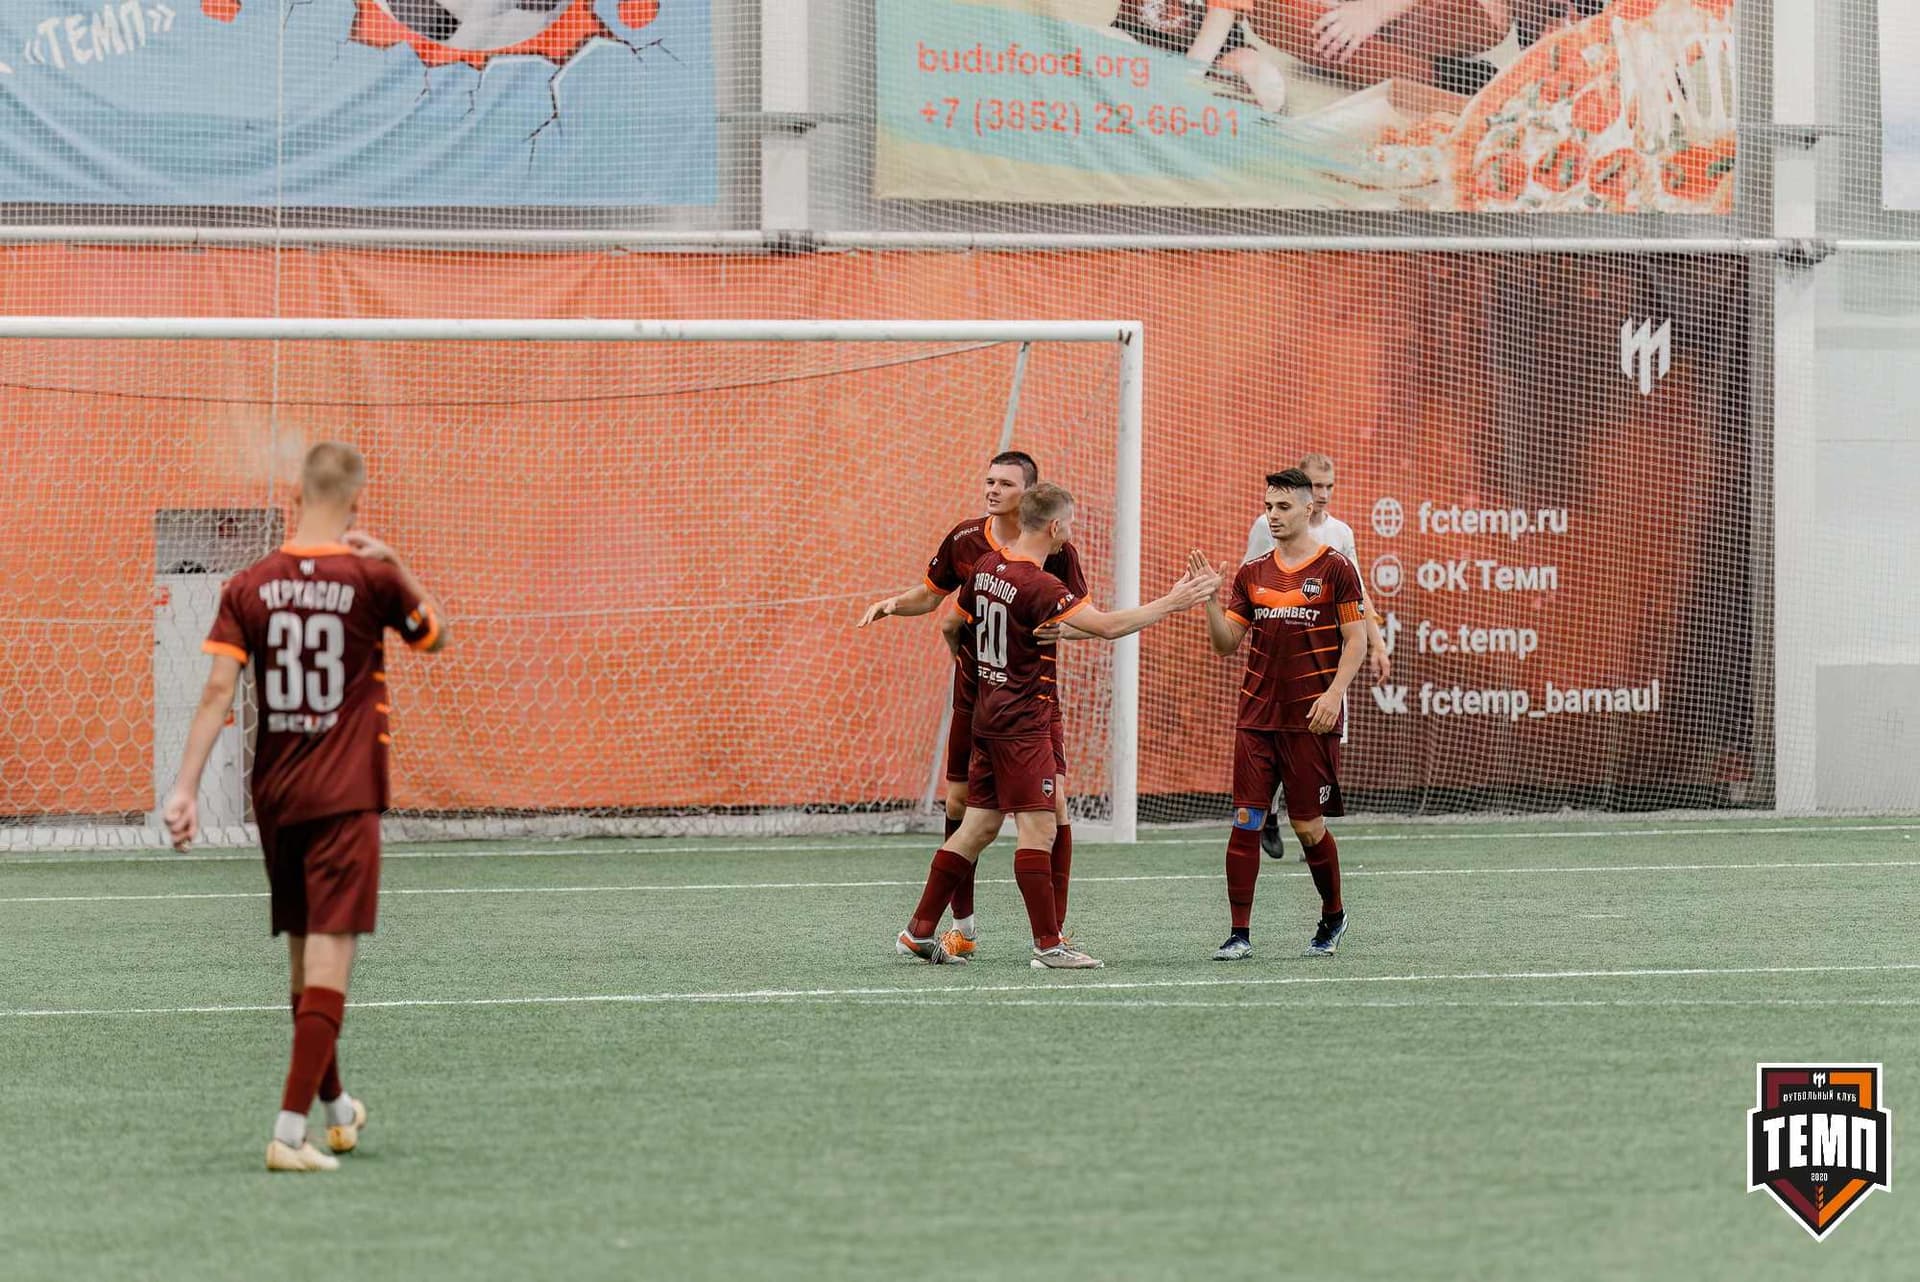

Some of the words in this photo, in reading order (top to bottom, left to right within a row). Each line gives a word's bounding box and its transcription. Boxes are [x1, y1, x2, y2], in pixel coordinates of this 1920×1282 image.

[23, 0, 176, 70] «ТЕМП»
[916, 41, 1151, 88] budufood.org
[918, 98, 960, 130] +7
[973, 98, 1082, 137] (3852)
[1094, 103, 1240, 137] 22-66-01
[1418, 502, 1568, 540] fctemp.ru
[1416, 558, 1469, 592] ФК
[1476, 559, 1558, 592] Темп
[976, 595, 1008, 669] 20
[1416, 621, 1537, 660] fc.temp
[265, 611, 345, 713] 33
[1420, 679, 1660, 721] fctemp_barnaul
[1319, 785, 1331, 804] 23
